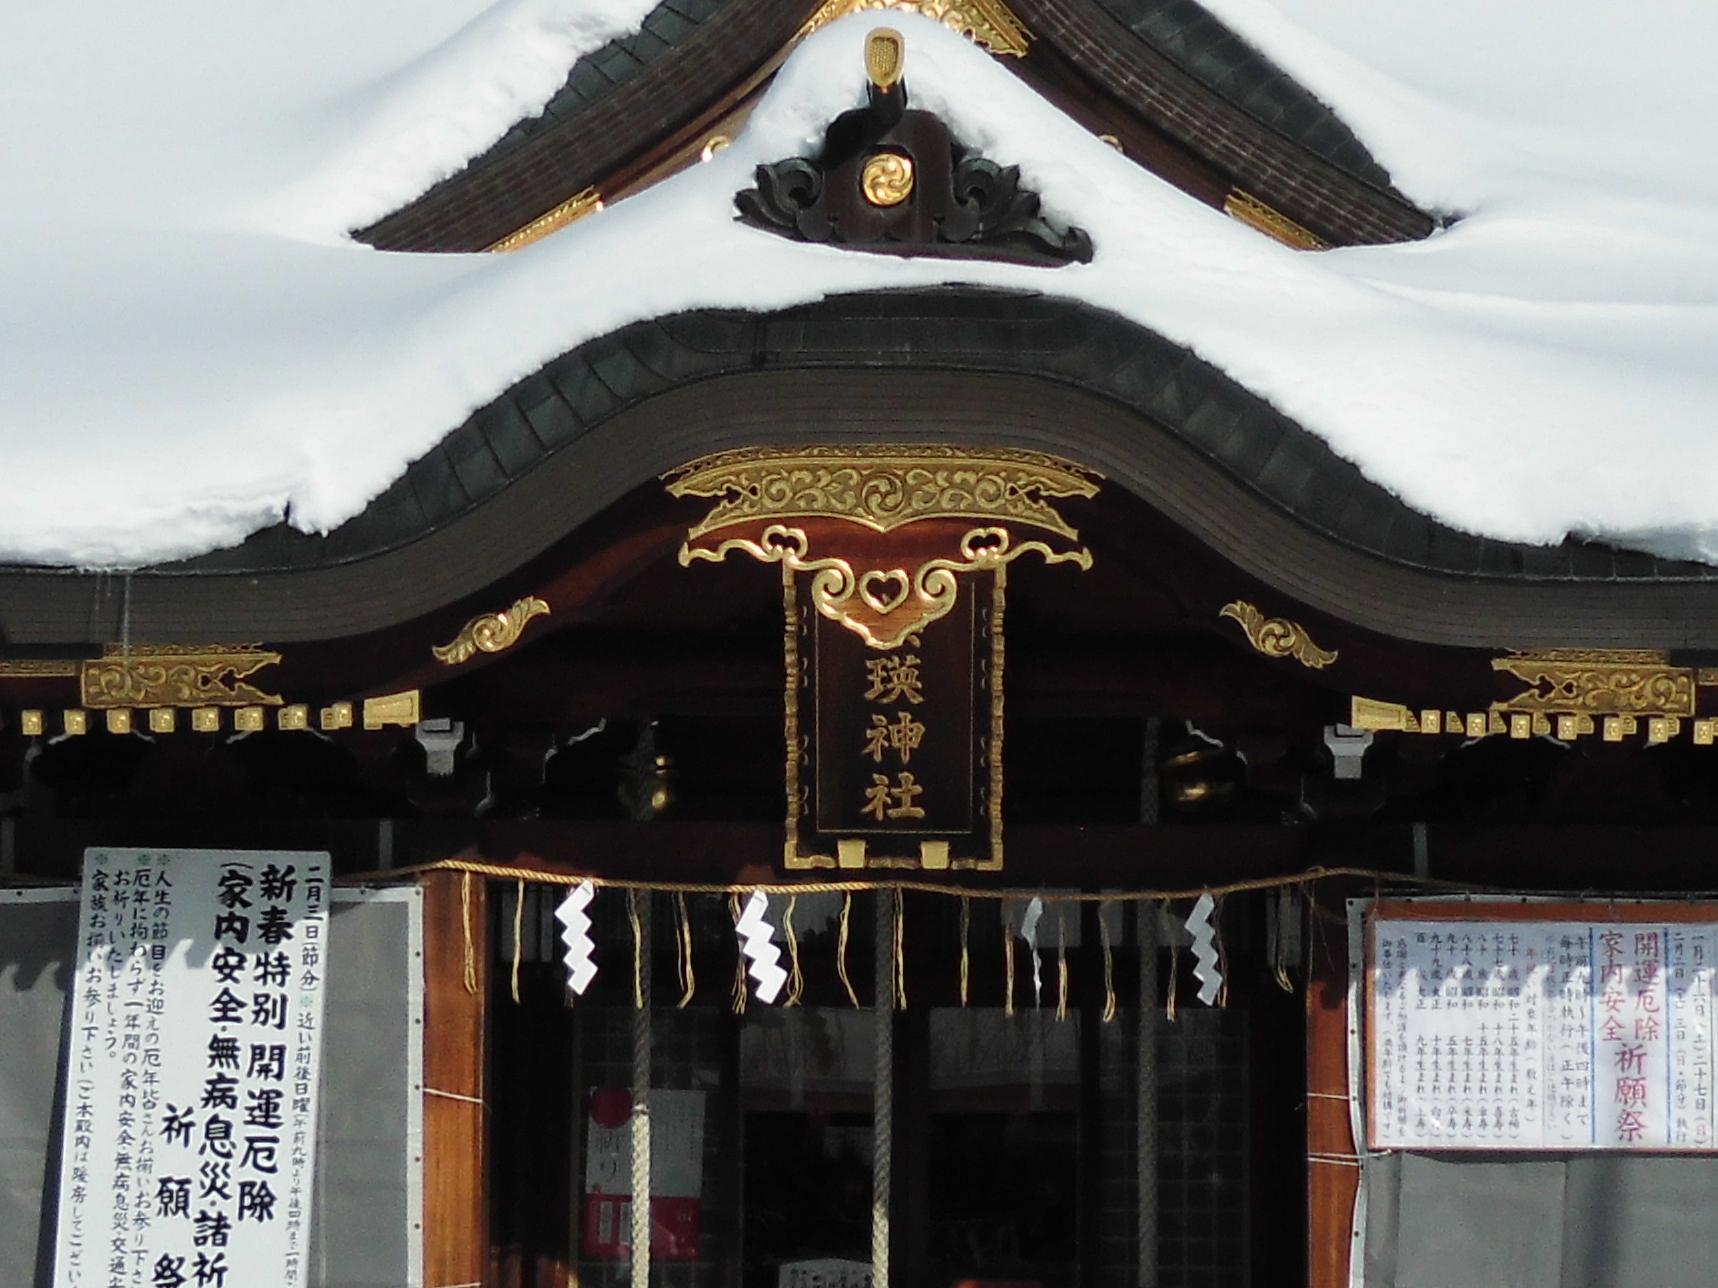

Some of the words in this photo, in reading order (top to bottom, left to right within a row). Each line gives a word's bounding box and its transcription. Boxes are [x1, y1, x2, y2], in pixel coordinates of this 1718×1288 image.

[861, 633, 927, 822] 瑛神社
[250, 864, 297, 1030] 新春特別
[1599, 930, 1625, 1042] 家内安全
[1633, 931, 1662, 1042] 開運厄除
[237, 1043, 287, 1223] 開運厄除
[1614, 1042, 1649, 1143] 祈願祭
